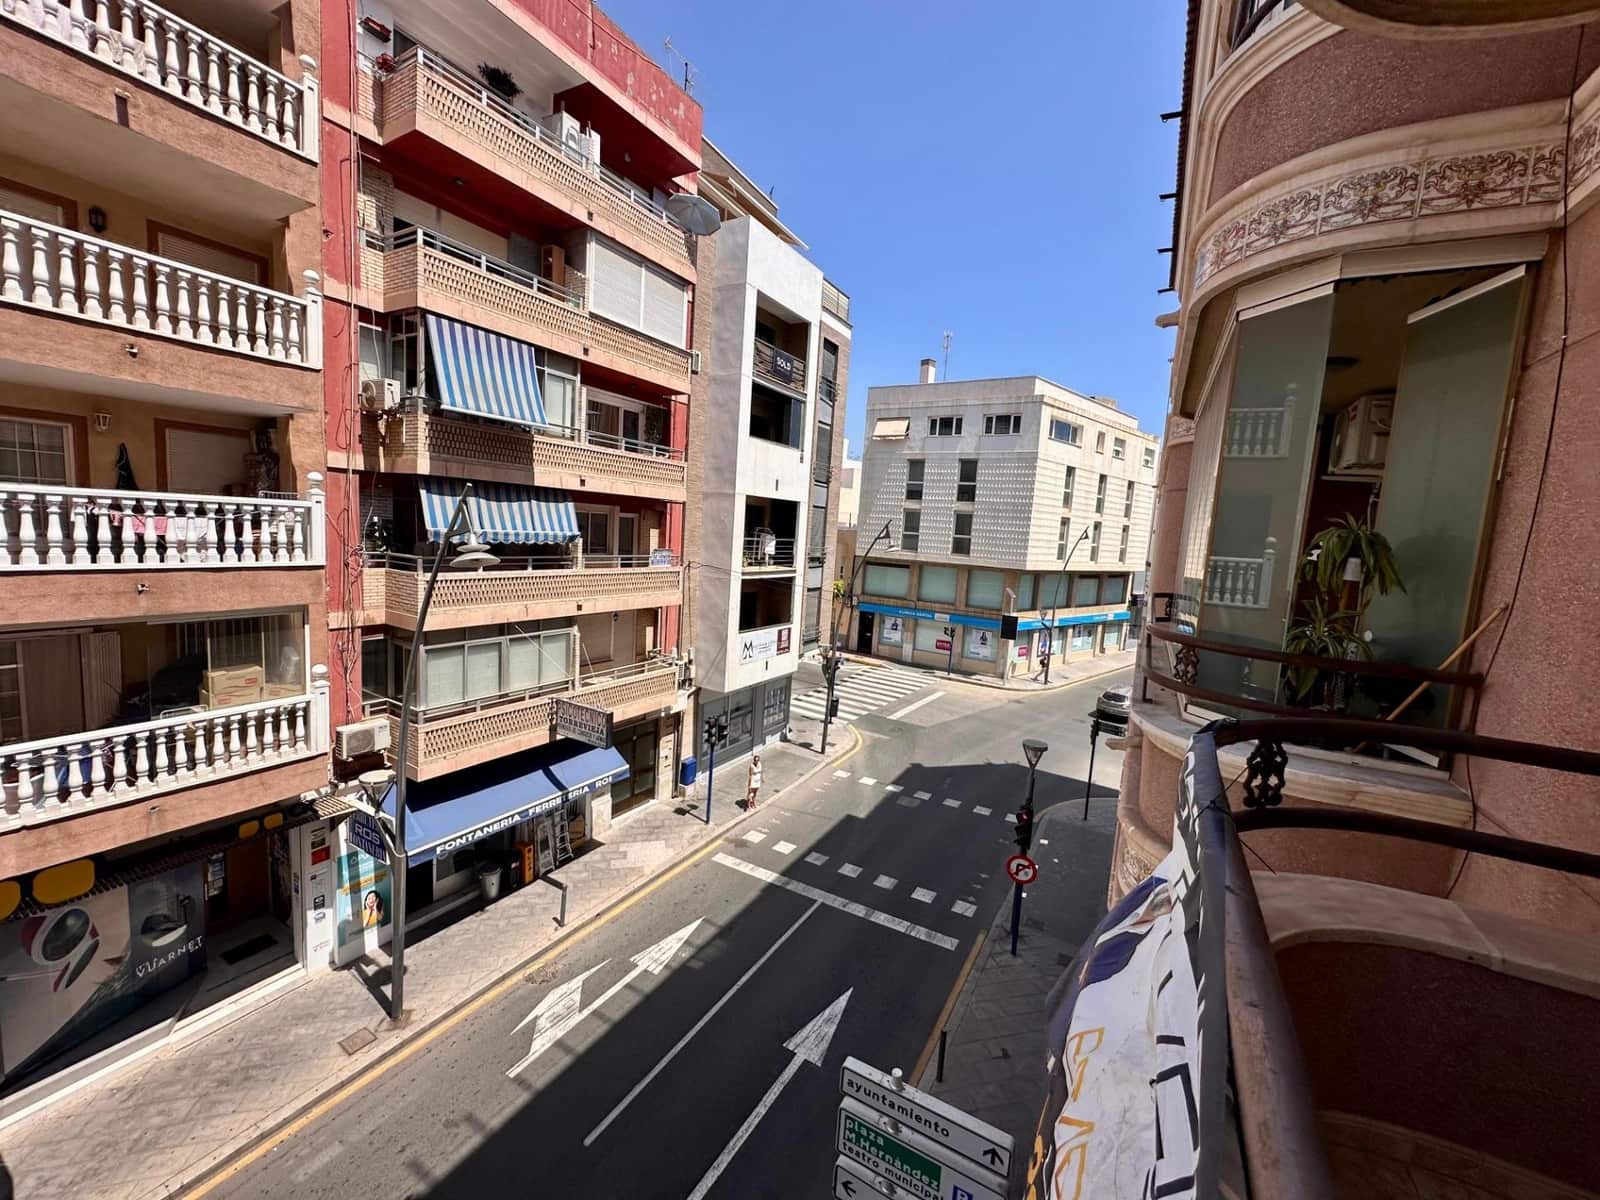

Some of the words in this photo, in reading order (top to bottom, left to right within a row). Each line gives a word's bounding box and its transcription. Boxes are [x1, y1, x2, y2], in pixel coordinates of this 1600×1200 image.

[776, 357, 792, 371] SOLD
[559, 715, 605, 737] TORREVIEJA
[354, 823, 380, 845] ROS
[435, 814, 522, 855] FONTANERIA
[847, 1077, 951, 1138] ayuntamiento
[846, 1119, 884, 1145] plaza
[842, 1141, 880, 1168] teatro
